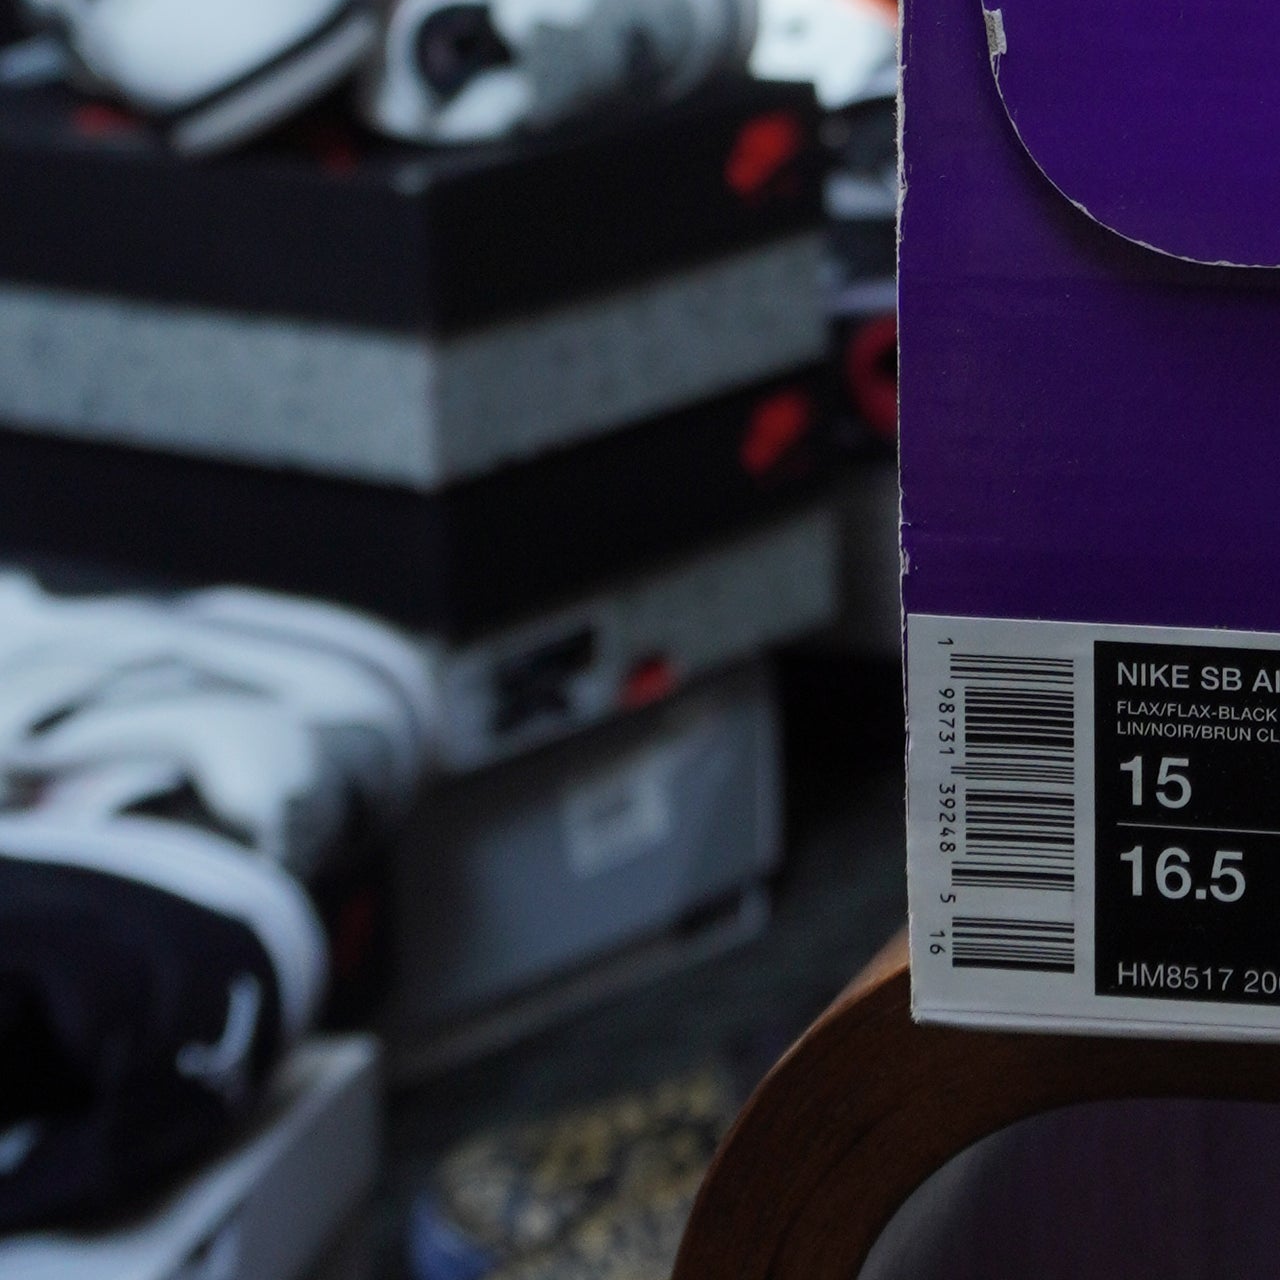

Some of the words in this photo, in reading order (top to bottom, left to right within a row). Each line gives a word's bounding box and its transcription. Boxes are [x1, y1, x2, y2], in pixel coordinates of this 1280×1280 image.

[937, 637, 954, 647] 1
[1117, 661, 1191, 689] NIKE
[1200, 666, 1243, 692] SB
[938, 688, 955, 755] 98731
[1116, 701, 1278, 723] FLAX/FLAX-BLACK
[1116, 721, 1252, 742] LIN/NOIR/BRUN
[1120, 755, 1192, 809] 15
[939, 783, 956, 853] 39248
[1119, 845, 1247, 903] 16.5
[939, 893, 956, 904] 5
[929, 930, 945, 955] 16
[1117, 962, 1234, 991] HM8517
